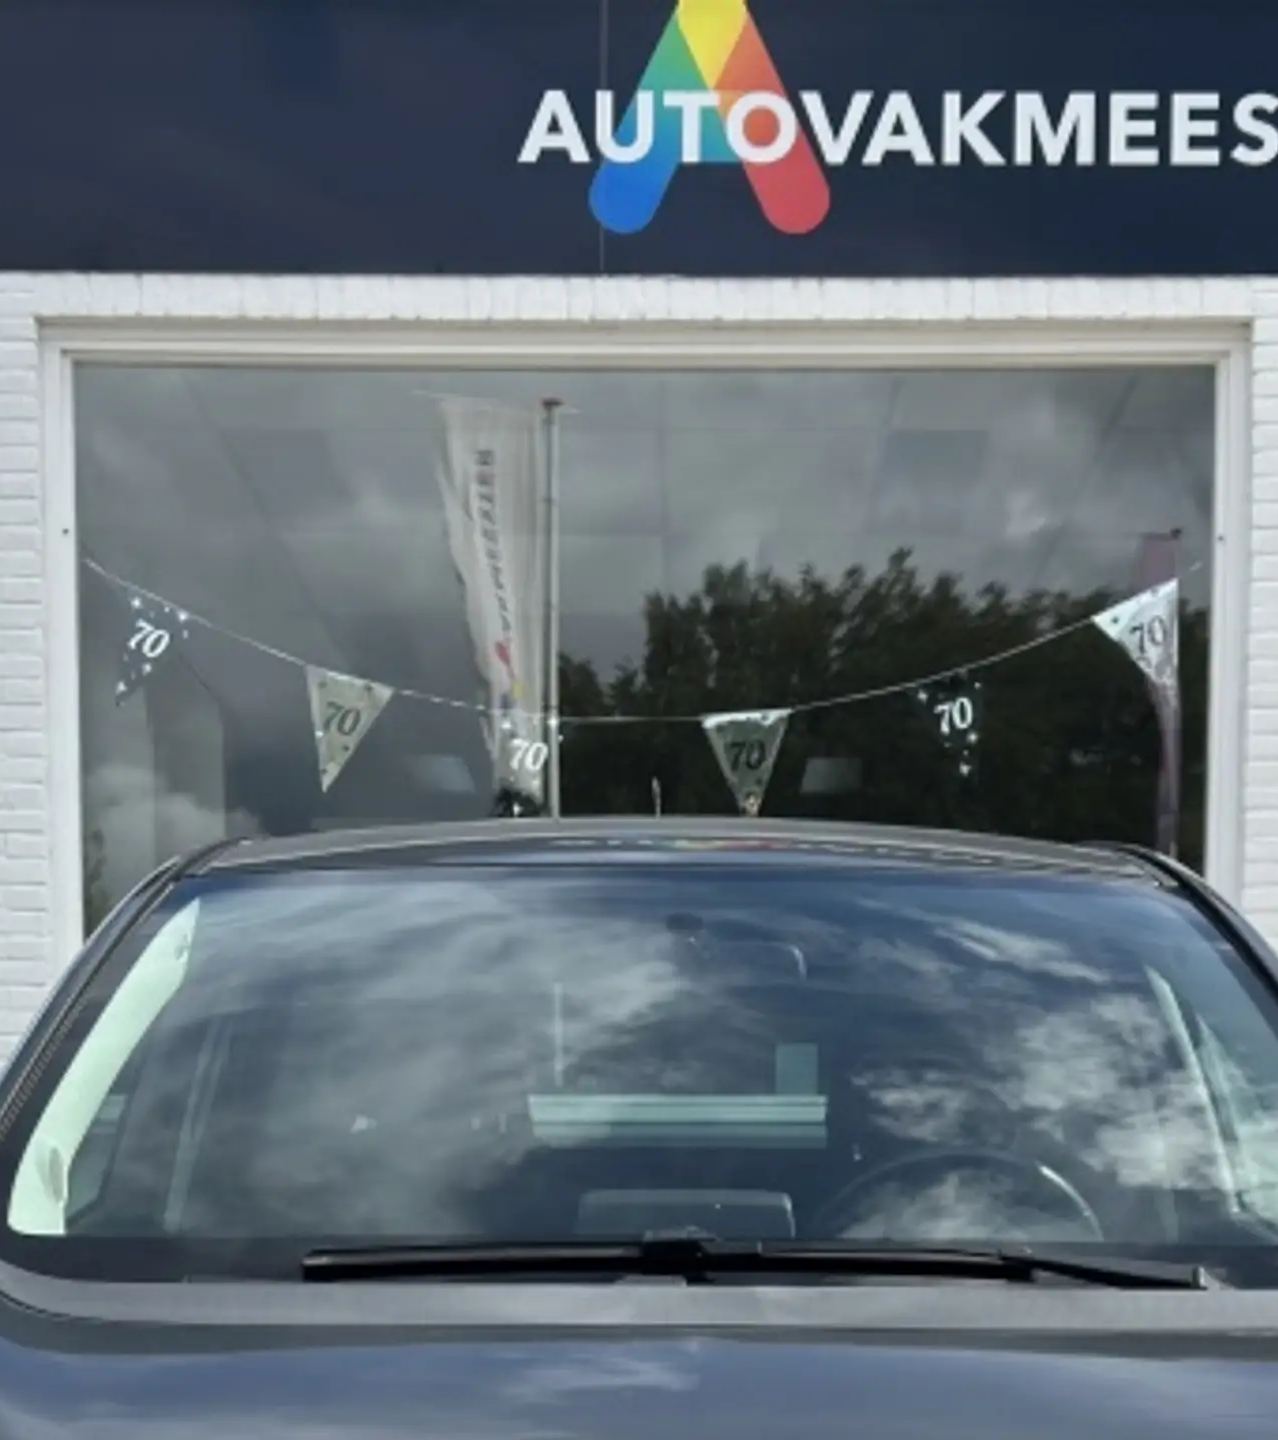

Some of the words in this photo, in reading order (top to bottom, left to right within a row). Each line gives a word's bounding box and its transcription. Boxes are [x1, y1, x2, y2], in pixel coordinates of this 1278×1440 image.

[126, 619, 171, 659] 70
[1130, 614, 1167, 655] 70
[322, 700, 361, 737] 70
[934, 697, 973, 734] 70
[508, 738, 549, 773] 70
[727, 739, 766, 772] 70
